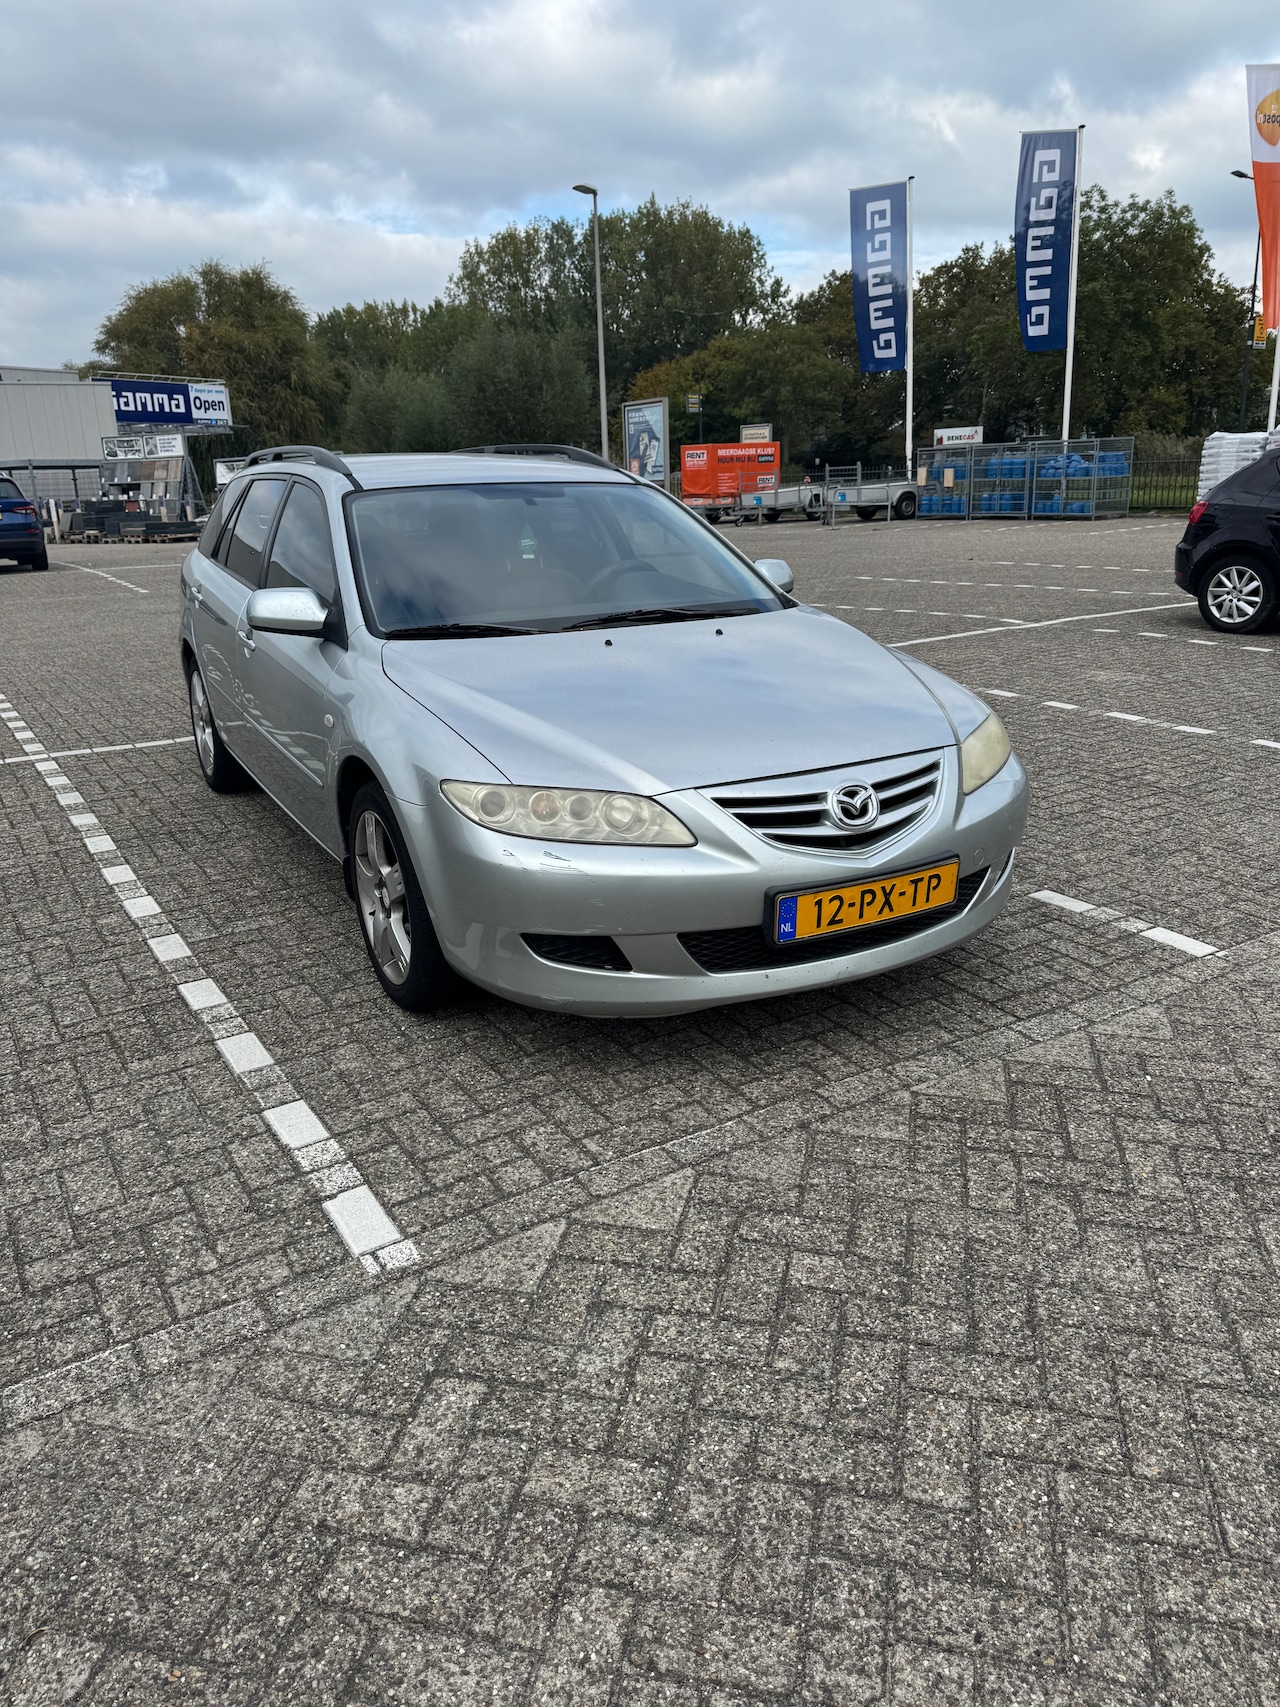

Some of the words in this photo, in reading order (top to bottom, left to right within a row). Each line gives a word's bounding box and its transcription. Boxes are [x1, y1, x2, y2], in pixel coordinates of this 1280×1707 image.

[193, 395, 226, 414] Open
[946, 434, 975, 442] BENEGAS
[717, 448, 756, 456] MEERDAAGSE
[717, 456, 735, 464] HUUR
[747, 455, 756, 463] BIJ
[813, 873, 942, 929] 12-PX-TP
[780, 922, 794, 934] NL
